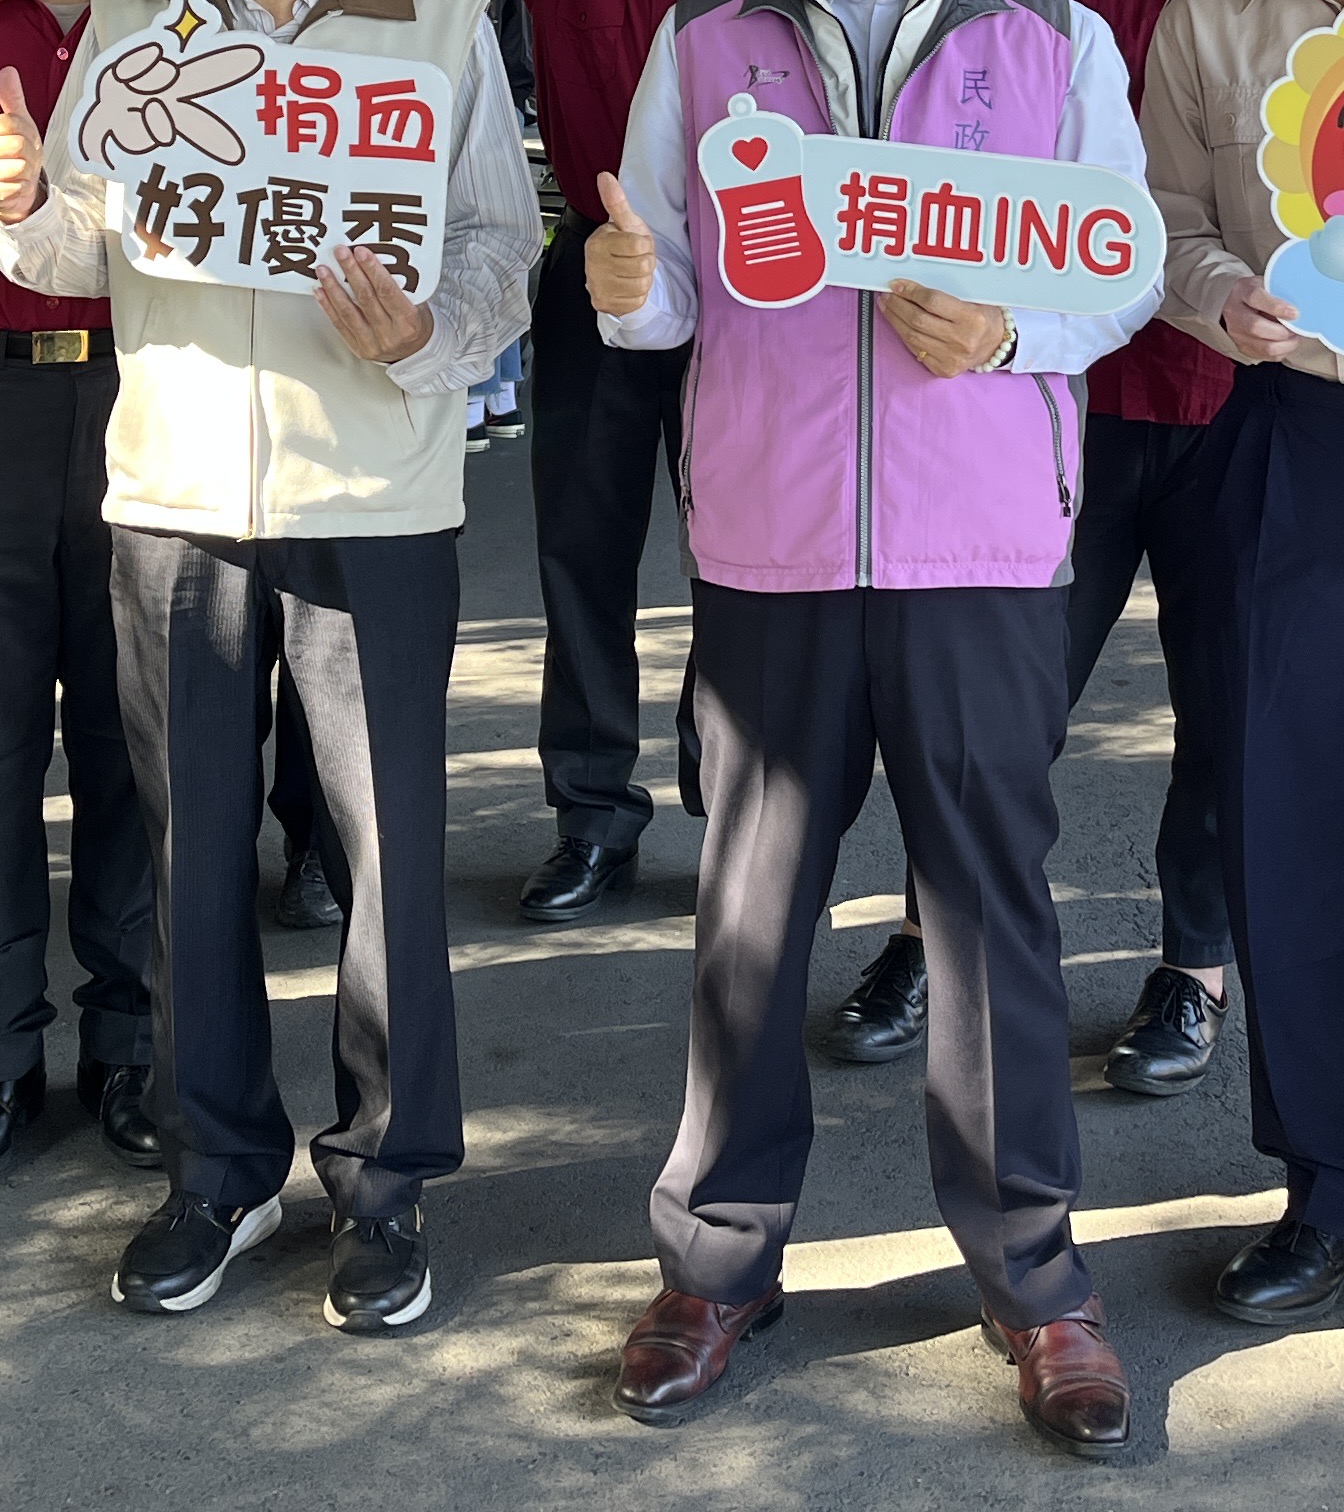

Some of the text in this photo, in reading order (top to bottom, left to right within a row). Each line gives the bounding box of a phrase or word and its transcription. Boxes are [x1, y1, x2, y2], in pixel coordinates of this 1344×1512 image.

[255, 62, 436, 162] 捐血
[133, 163, 428, 294] 好優秀
[837, 171, 1133, 276] 捐血ING
